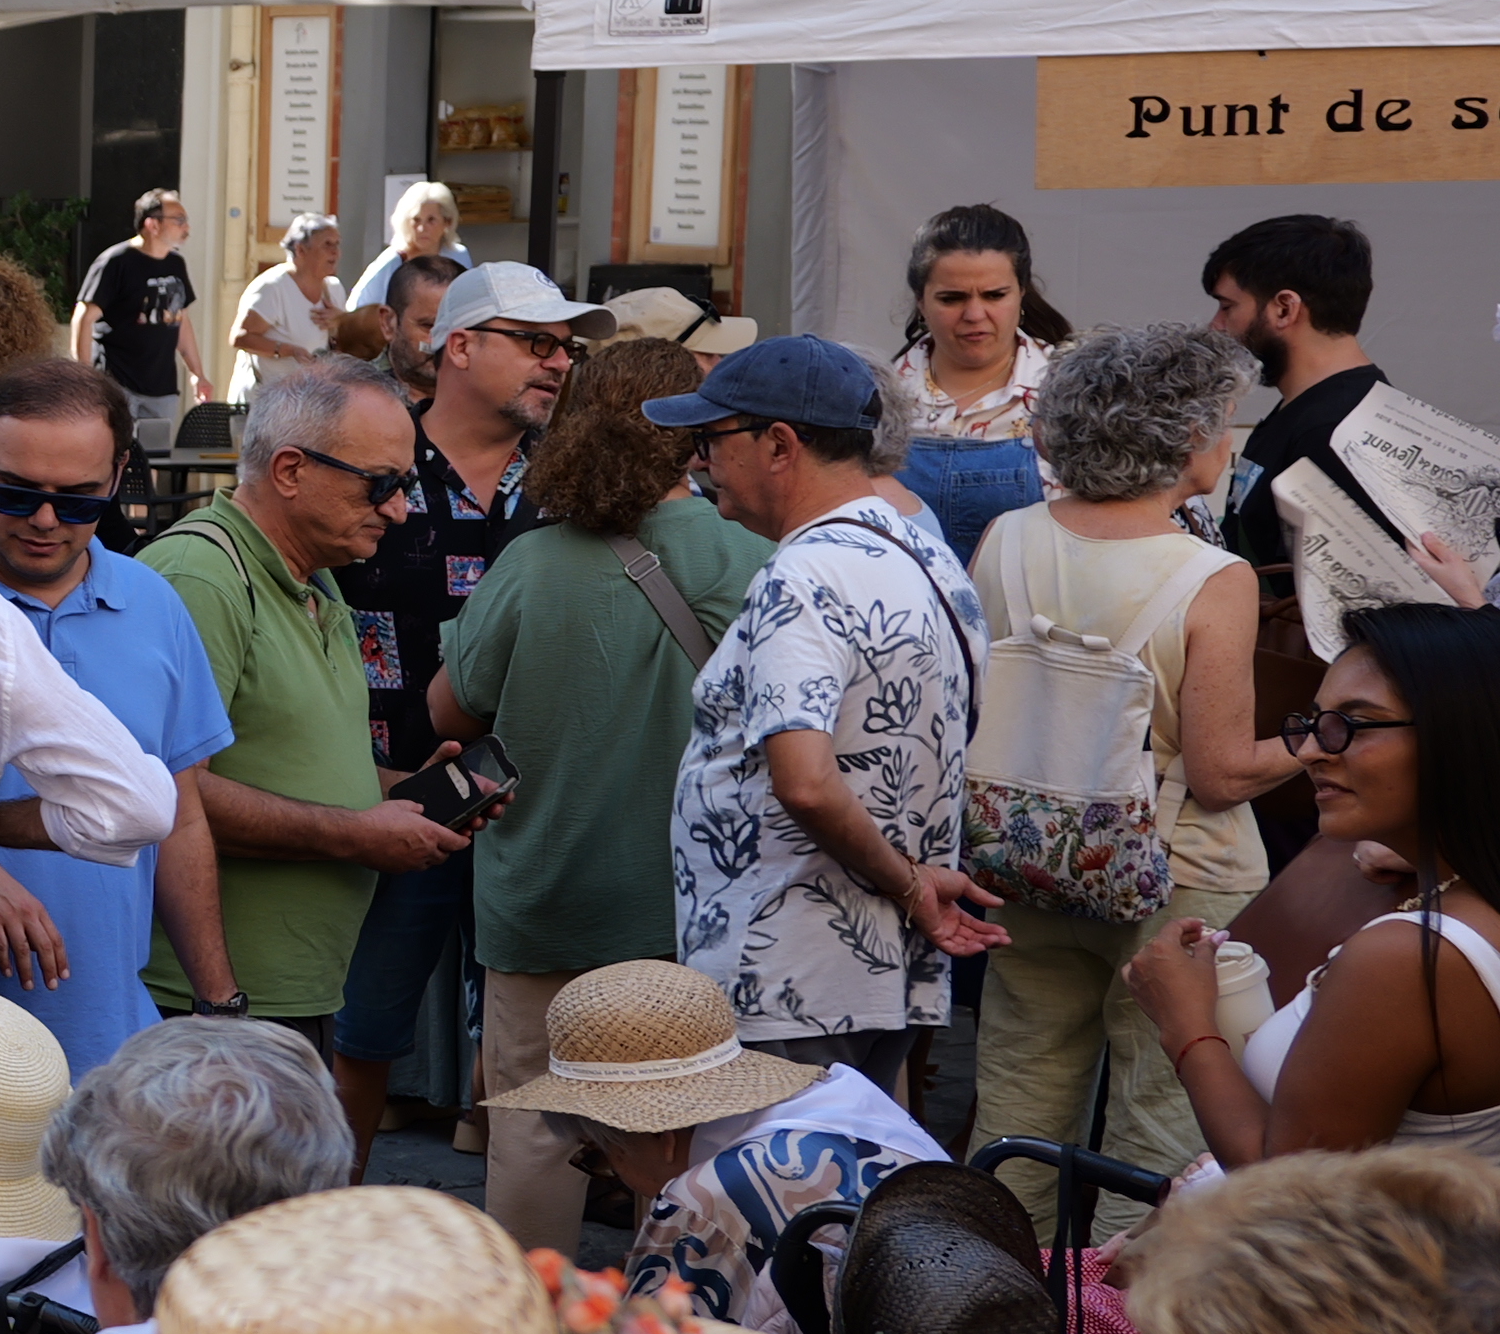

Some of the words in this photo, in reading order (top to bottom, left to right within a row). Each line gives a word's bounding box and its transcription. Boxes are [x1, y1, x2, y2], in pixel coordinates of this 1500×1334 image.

[1125, 93, 1290, 138] Punt
[1325, 89, 1413, 133] de
[1451, 95, 1500, 131] s
